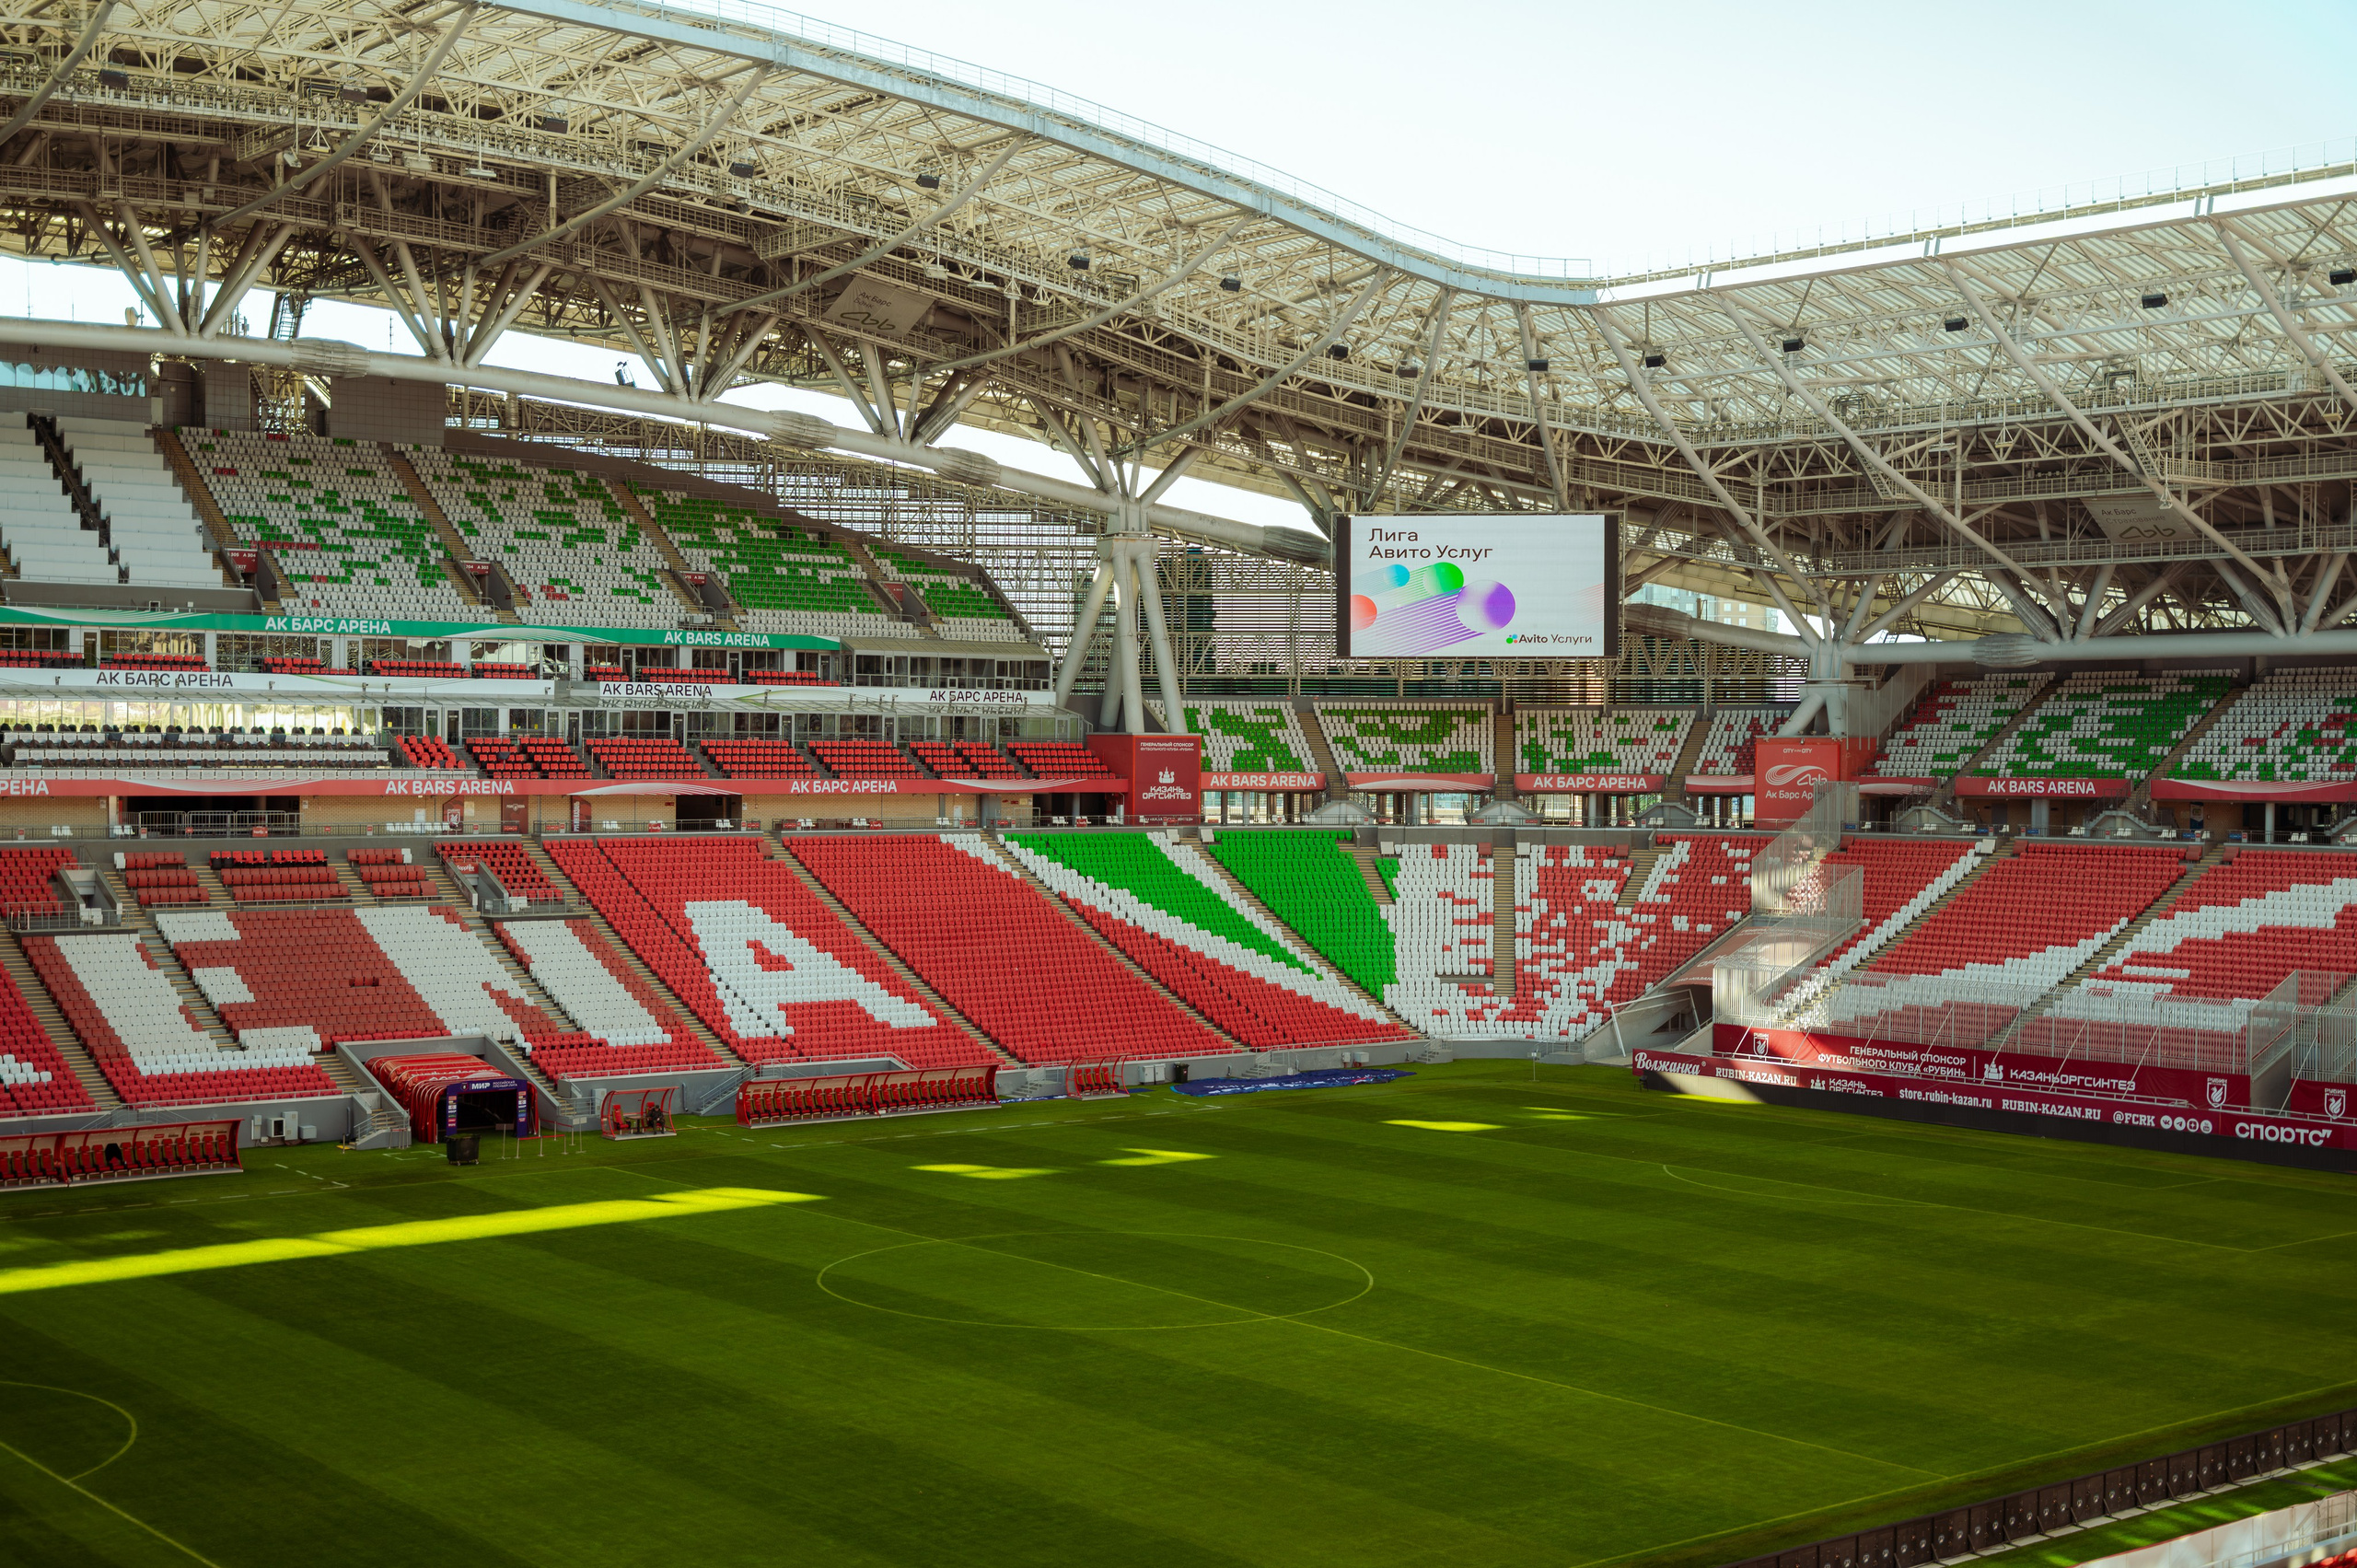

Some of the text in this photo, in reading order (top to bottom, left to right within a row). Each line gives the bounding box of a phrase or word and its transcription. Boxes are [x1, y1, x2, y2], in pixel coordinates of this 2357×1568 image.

[1368, 528, 1419, 541] Лига
[1368, 545, 1493, 562] Авито Услуг
[265, 617, 391, 633] АК БАРС АРЕНА
[664, 632, 770, 646] AK BARS ARENA
[1519, 633, 1593, 645] Avito Услуги
[97, 672, 233, 687] АК БАРС АРЕНА
[602, 683, 713, 696] AK BARS ARENA
[930, 691, 1023, 703] АК БАРС АРЕНА
[385, 781, 514, 794] AK BARS ARENA
[790, 781, 897, 794] АК БАРС АРЕНА
[1210, 775, 1317, 787] AK BARS ARENA
[1534, 777, 1647, 788] АК БАРС АРЕНА
[1987, 781, 2096, 794] AK BARS ARENA
[1766, 790, 1777, 799] Ак
[1779, 790, 1799, 800] Барс
[1635, 1051, 1701, 1075] Волжанка
[1850, 1046, 1967, 1066] ГЕНЕРАЛЬНЫЙ СПОНСОР
[1817, 1053, 1966, 1077] ФУТБОЛЬНОГО КЛУБА «РУБИН»
[1715, 1067, 1797, 1086] RUBIN-KAZAN.RU
[1829, 1078, 1866, 1089] КАЗАНЬ
[2011, 1069, 2136, 1090] КАЗАНЬОРГСИНТЕЗ
[1899, 1088, 1992, 1109] store.rubin-kazan.ru
[2002, 1099, 2101, 1120] RUBIN-KAZAN.RU
[2113, 1111, 2155, 1127] @FCRK
